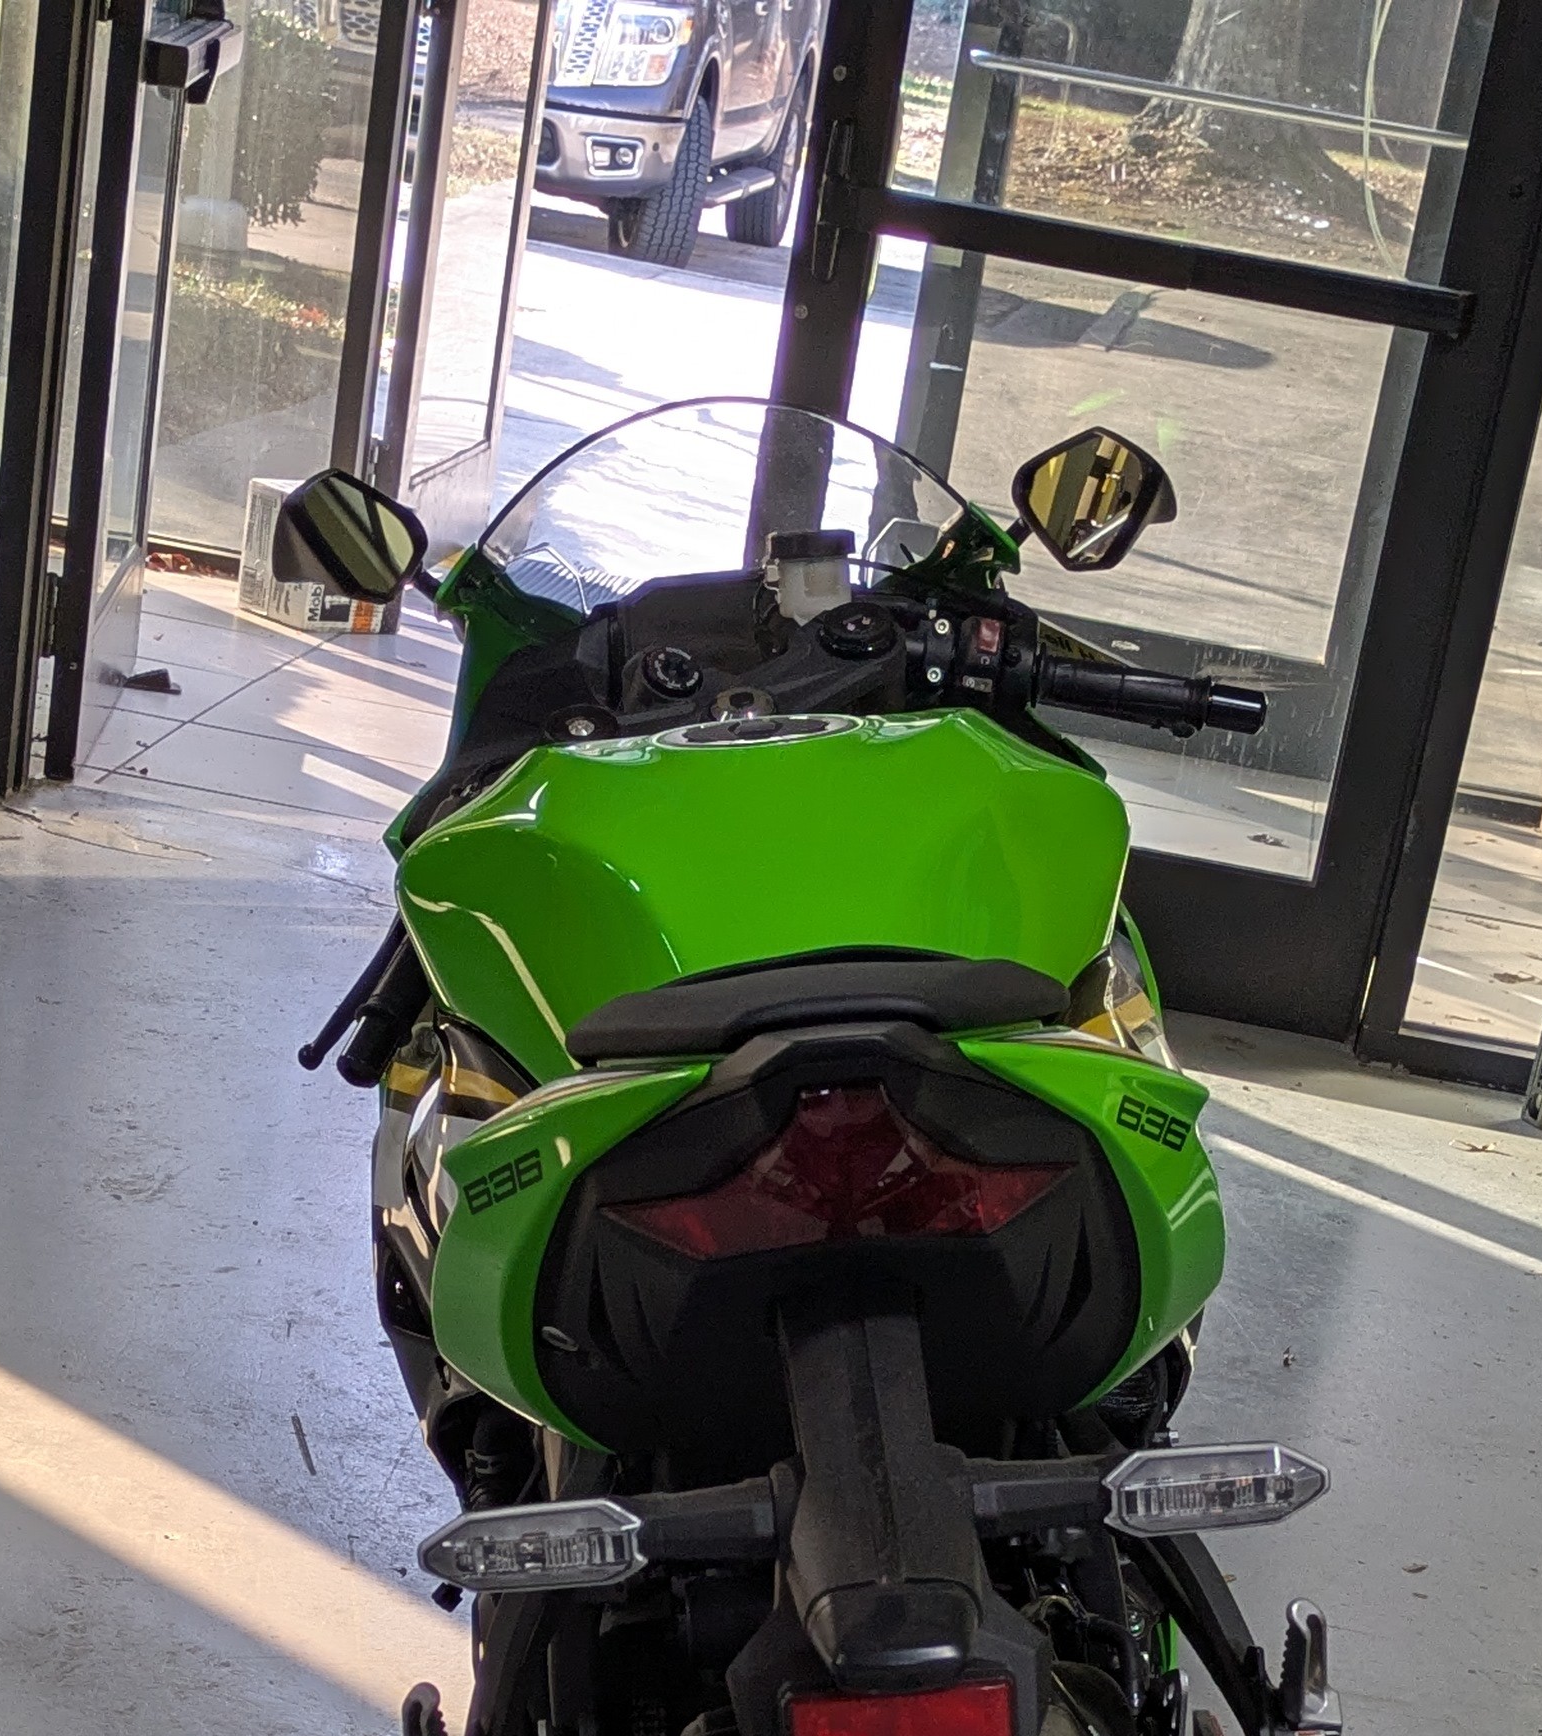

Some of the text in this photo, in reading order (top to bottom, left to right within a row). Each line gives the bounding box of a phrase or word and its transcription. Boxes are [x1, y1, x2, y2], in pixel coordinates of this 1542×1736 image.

[307, 585, 324, 622] Mob
[1117, 1095, 1191, 1152] 636
[463, 1149, 543, 1215] 636
